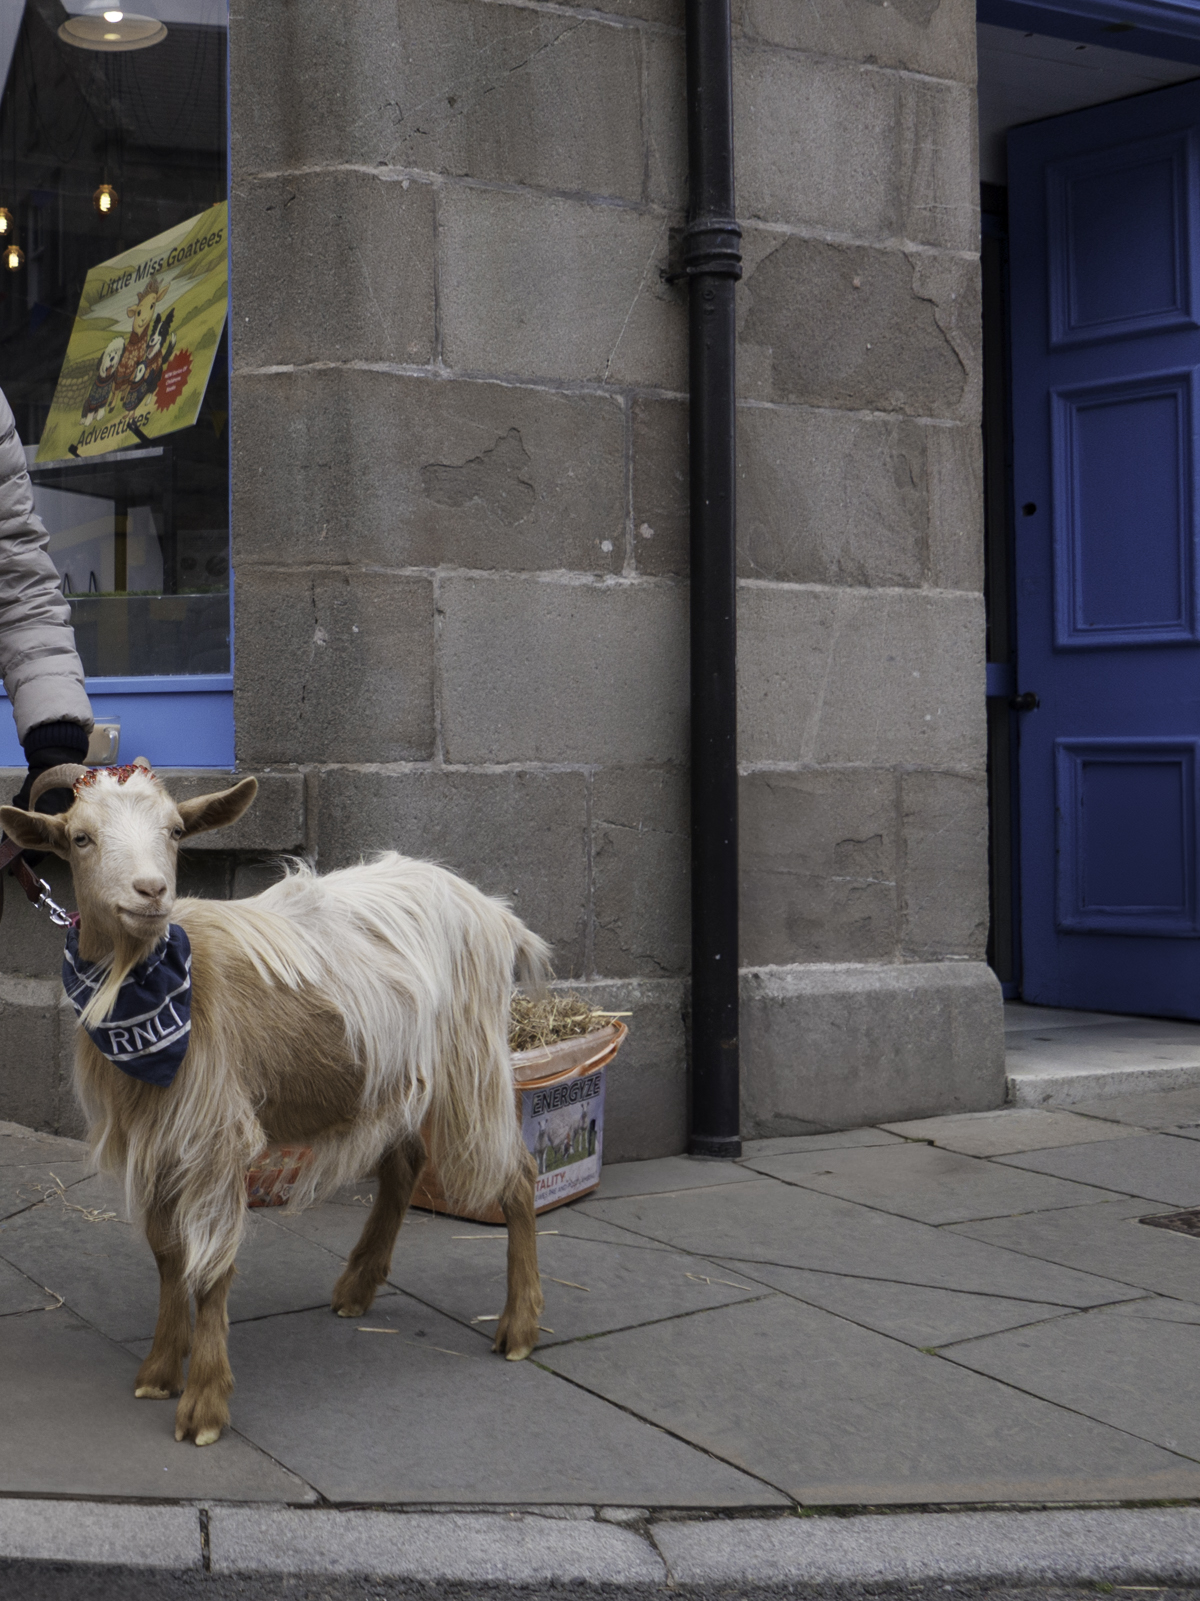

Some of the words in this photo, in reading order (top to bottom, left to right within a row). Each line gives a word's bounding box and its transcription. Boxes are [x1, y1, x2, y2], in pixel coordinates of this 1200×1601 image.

[100, 272, 133, 299] Little
[134, 258, 164, 284] Miss
[166, 228, 224, 267] Goatees
[108, 1001, 184, 1055] RNLI
[531, 1073, 601, 1117] ENERGYZE
[535, 1171, 567, 1192] TALITY
